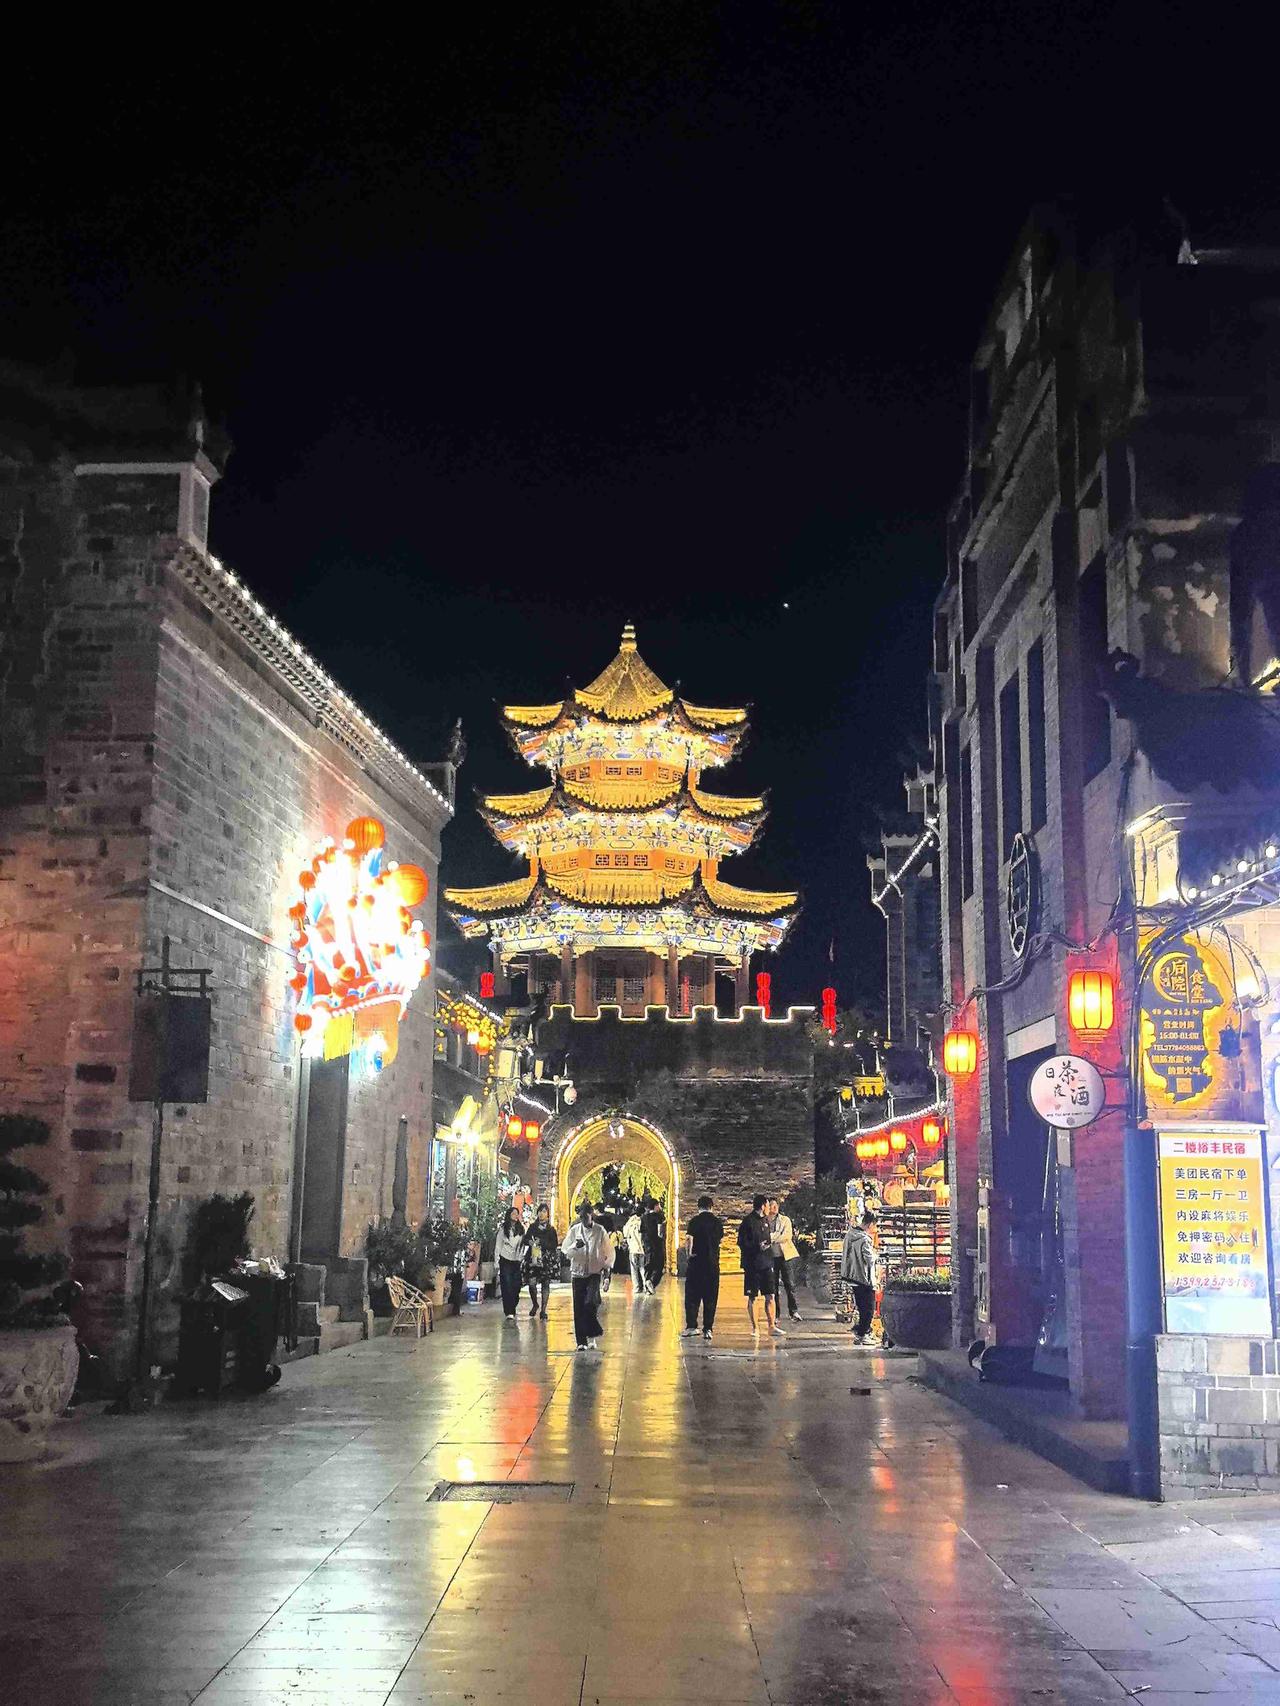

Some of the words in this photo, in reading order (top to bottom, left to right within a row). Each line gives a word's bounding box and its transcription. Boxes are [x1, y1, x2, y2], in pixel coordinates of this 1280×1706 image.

[1189, 969, 1205, 999] 食堂
[1173, 1142, 1246, 1154] 二楼裕丰民宿
[1174, 1167, 1248, 1180] 美团民宿下单
[1175, 1189, 1248, 1201] 三房一厅一卫
[1176, 1210, 1249, 1222] 内设麻将娱乐
[1177, 1231, 1250, 1245] 免押密码入住
[1178, 1252, 1251, 1265] 欢迎咨询看房
